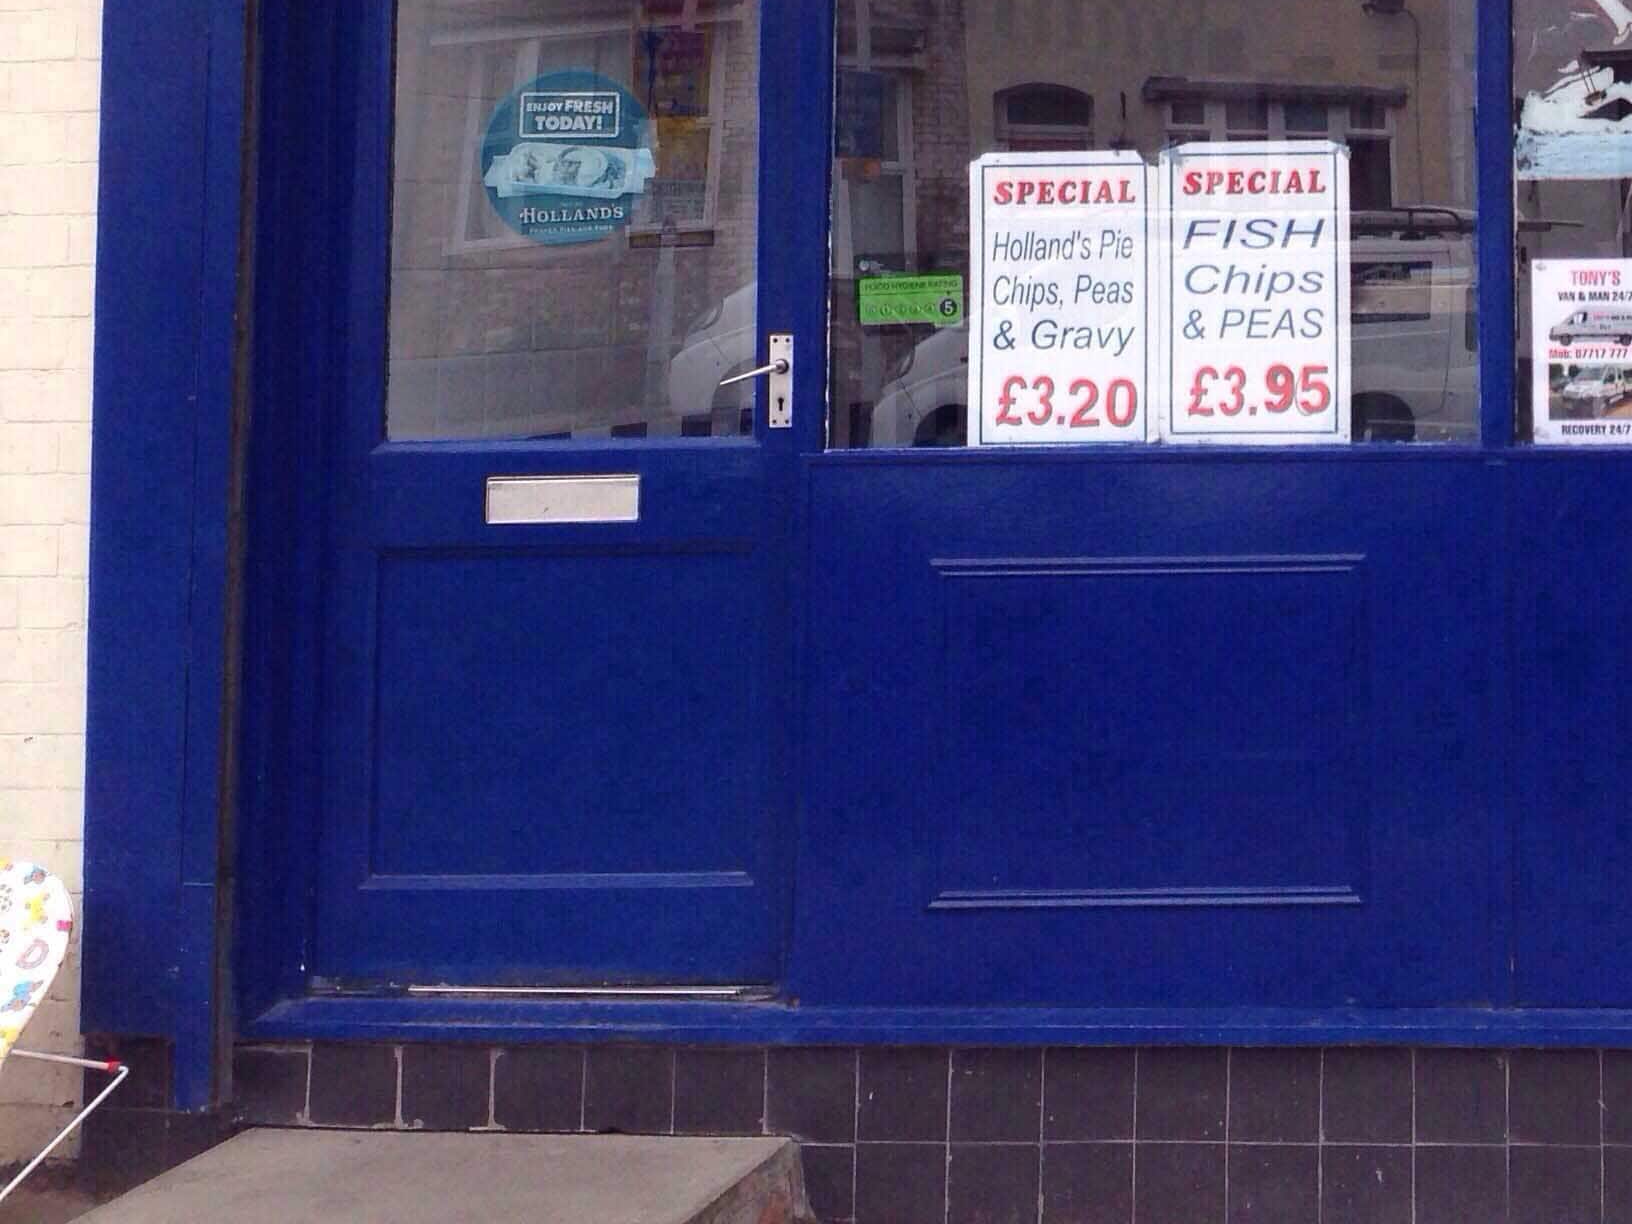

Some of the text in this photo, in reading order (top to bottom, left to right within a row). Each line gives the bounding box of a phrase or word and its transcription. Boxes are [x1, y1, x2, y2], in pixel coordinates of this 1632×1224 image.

[526, 99, 614, 115] ENJOY FRESH
[534, 115, 603, 132] TODAY!
[992, 178, 1137, 206] SPECIAL
[1182, 168, 1328, 197] SPECIAL
[519, 203, 625, 225] HOLLAND'S
[991, 228, 1134, 264] Holland's Pie
[1181, 217, 1326, 251] FISH
[992, 274, 1135, 312] Chips, Peas
[1184, 261, 1326, 301] Chips
[1570, 269, 1622, 287] TONY'S
[1558, 291, 1576, 303] VAN
[1578, 291, 1587, 303] &
[1588, 291, 1610, 303] MAN
[992, 318, 1136, 358] & Gravy
[1182, 307, 1326, 341] & PEAS
[994, 374, 1140, 429] £3.20
[1187, 363, 1332, 418] £3.95
[1561, 424, 1607, 436] RECOVERY
